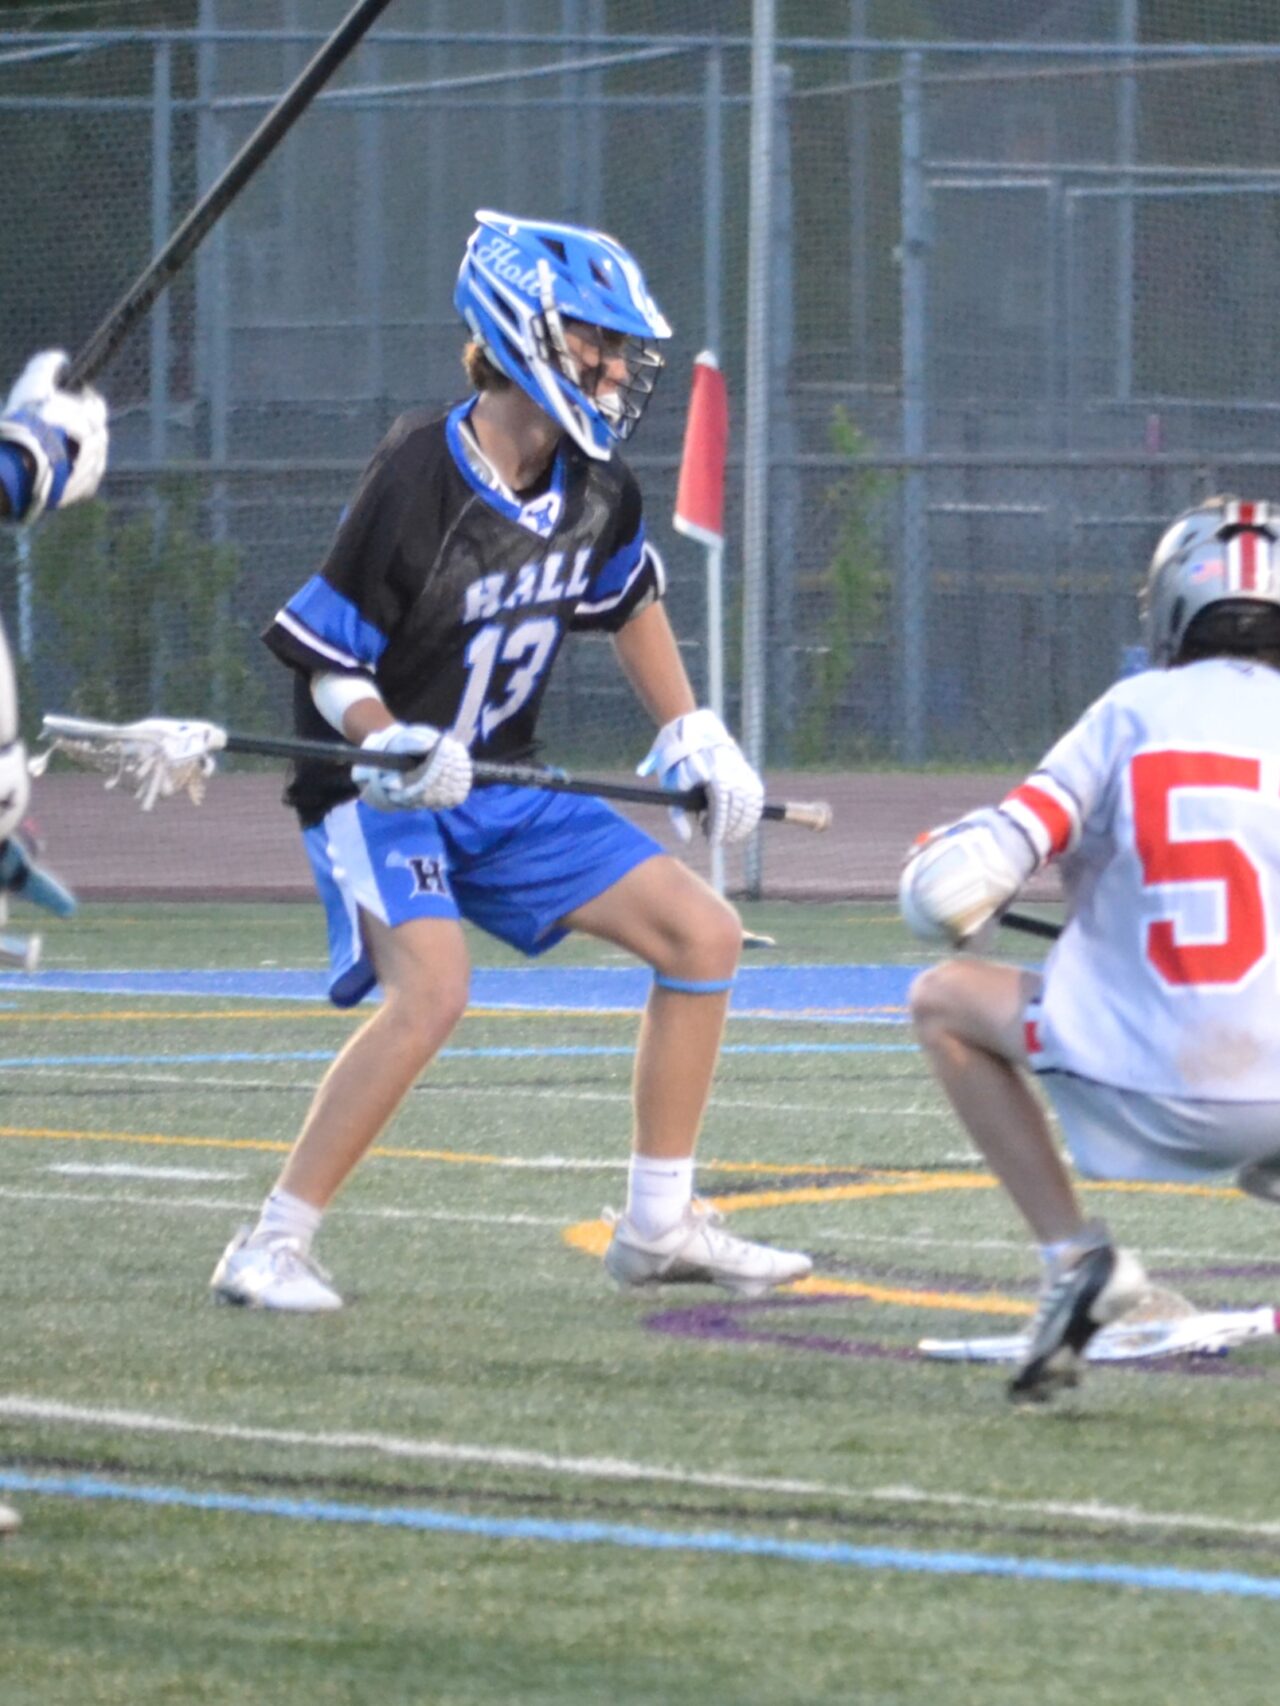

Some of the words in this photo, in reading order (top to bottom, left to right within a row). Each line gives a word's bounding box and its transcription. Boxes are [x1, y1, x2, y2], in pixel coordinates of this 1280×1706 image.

[463, 546, 593, 625] HALL
[451, 614, 562, 747] 13
[409, 857, 448, 894] H
